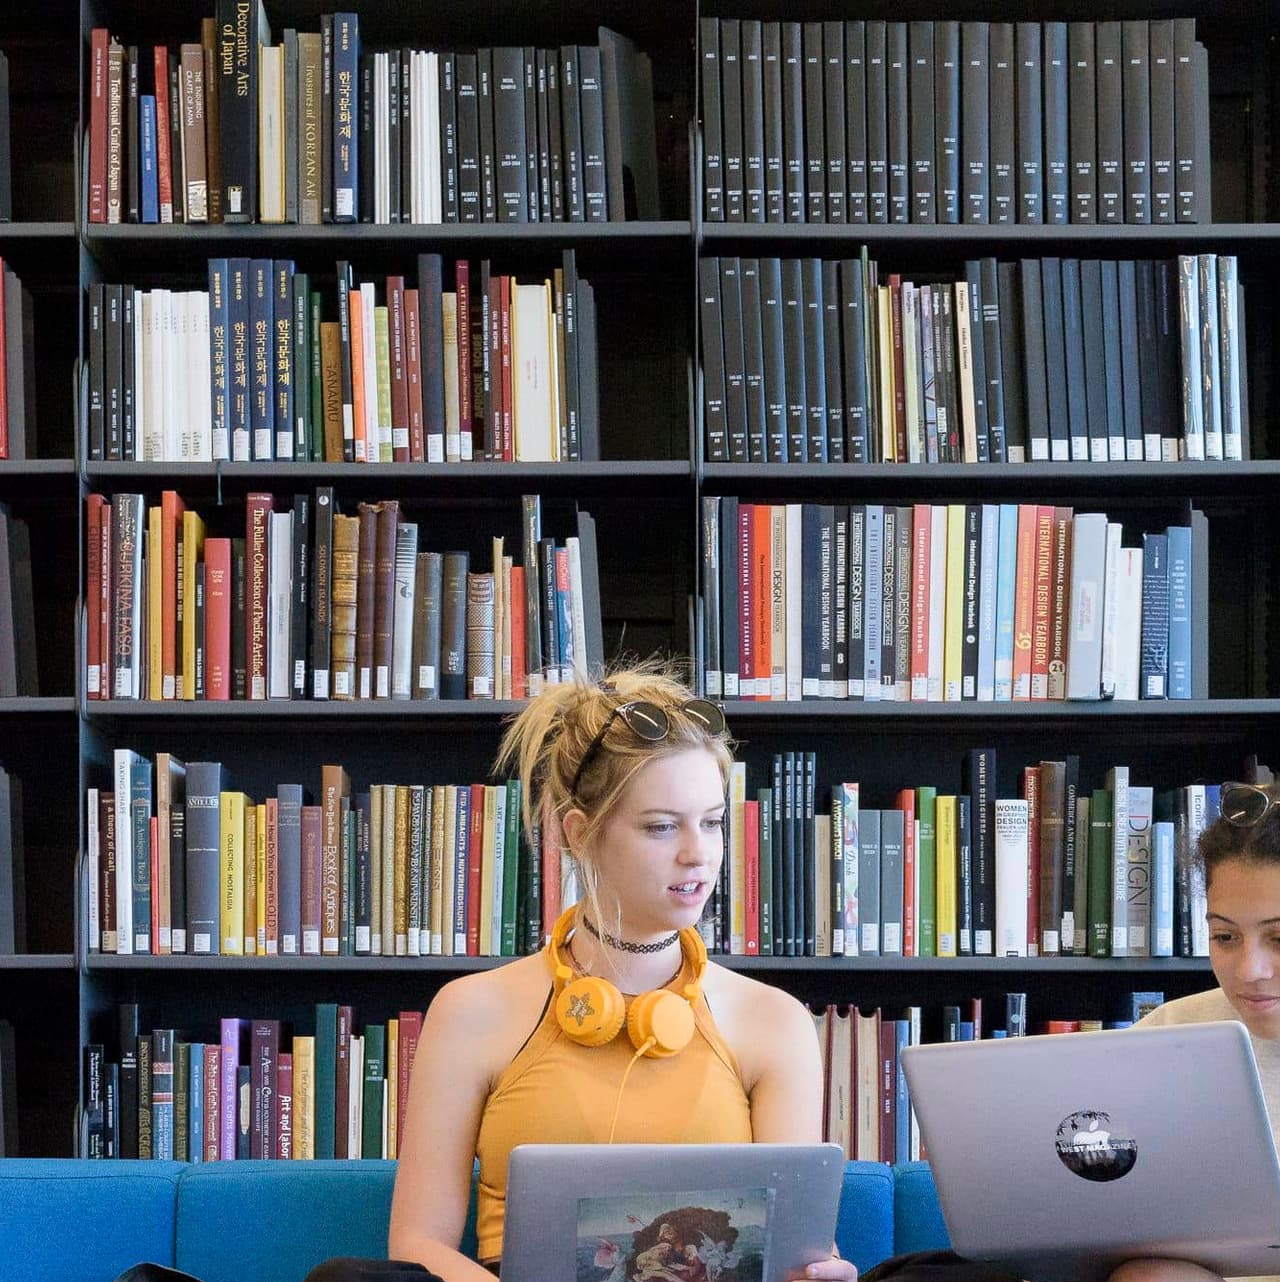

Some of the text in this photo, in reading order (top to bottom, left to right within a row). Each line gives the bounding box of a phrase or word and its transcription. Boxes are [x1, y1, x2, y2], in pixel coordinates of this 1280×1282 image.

[222, 24, 235, 74] of Japan
[237, 3, 249, 96] Decorative Arts
[110, 79, 120, 190] Traditional Crafts of Japan
[306, 64, 316, 196] Treasures of KOREAN AR
[338, 72, 351, 139] 한국문화재
[215, 326, 225, 389] 한국문화재
[235, 322, 245, 387] 한국문화재
[256, 321, 267, 386] 한국문화재
[279, 320, 289, 385] 한국문화재
[1057, 520, 1066, 583] INTERNATIONAL
[253, 508, 264, 677] The Fuller Collection of Pacific Artifact
[822, 527, 830, 650] THE INTERNATIONAL DESIGN YEARBOOK
[1035, 516, 1050, 665] INTERNATIONAL DESIGN YEARBOOK
[1056, 585, 1064, 612] DESIGN
[1054, 615, 1063, 657] YEARBOOK
[106, 814, 114, 839] theory
[1067, 785, 1075, 824] COMMERCE
[1117, 812, 1125, 856] CREATIVITY
[108, 842, 115, 850] of
[846, 850, 855, 875] Dish
[1128, 815, 1149, 905] DESIGN
[1116, 867, 1124, 901] CULTURE
[279, 1095, 291, 1158] Art and Labor
